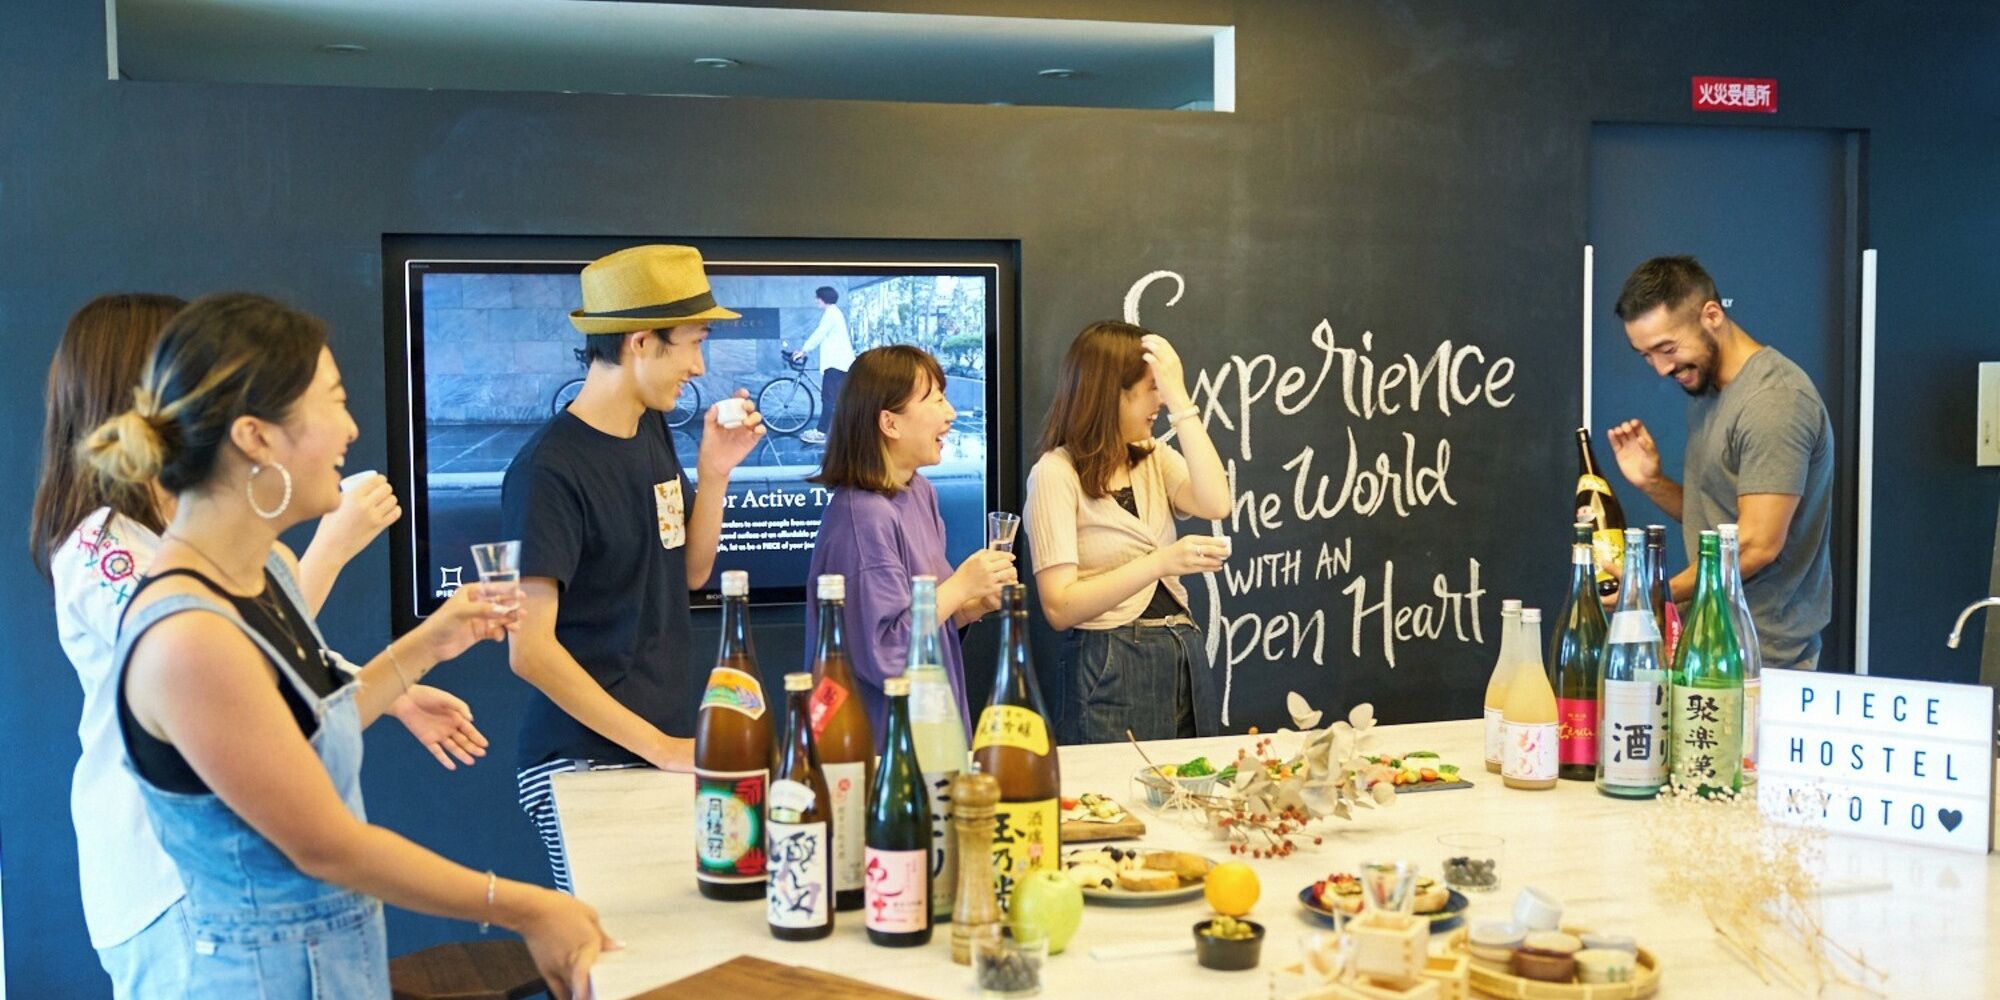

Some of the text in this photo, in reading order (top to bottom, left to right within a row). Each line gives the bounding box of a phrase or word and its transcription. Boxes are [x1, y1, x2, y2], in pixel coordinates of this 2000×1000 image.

[1699, 83, 1771, 106] 火災受信所
[741, 489, 806, 508] Active
[1226, 426, 1458, 538] he World
[762, 542, 780, 550] PIECE
[1223, 537, 1352, 597] WITH AN
[1342, 557, 1487, 668] Heart
[1801, 687, 1939, 725] PIECE
[1612, 722, 1653, 763] 酒
[1790, 737, 1958, 781] HOSTEL
[1787, 788, 1925, 830] KYOTO
